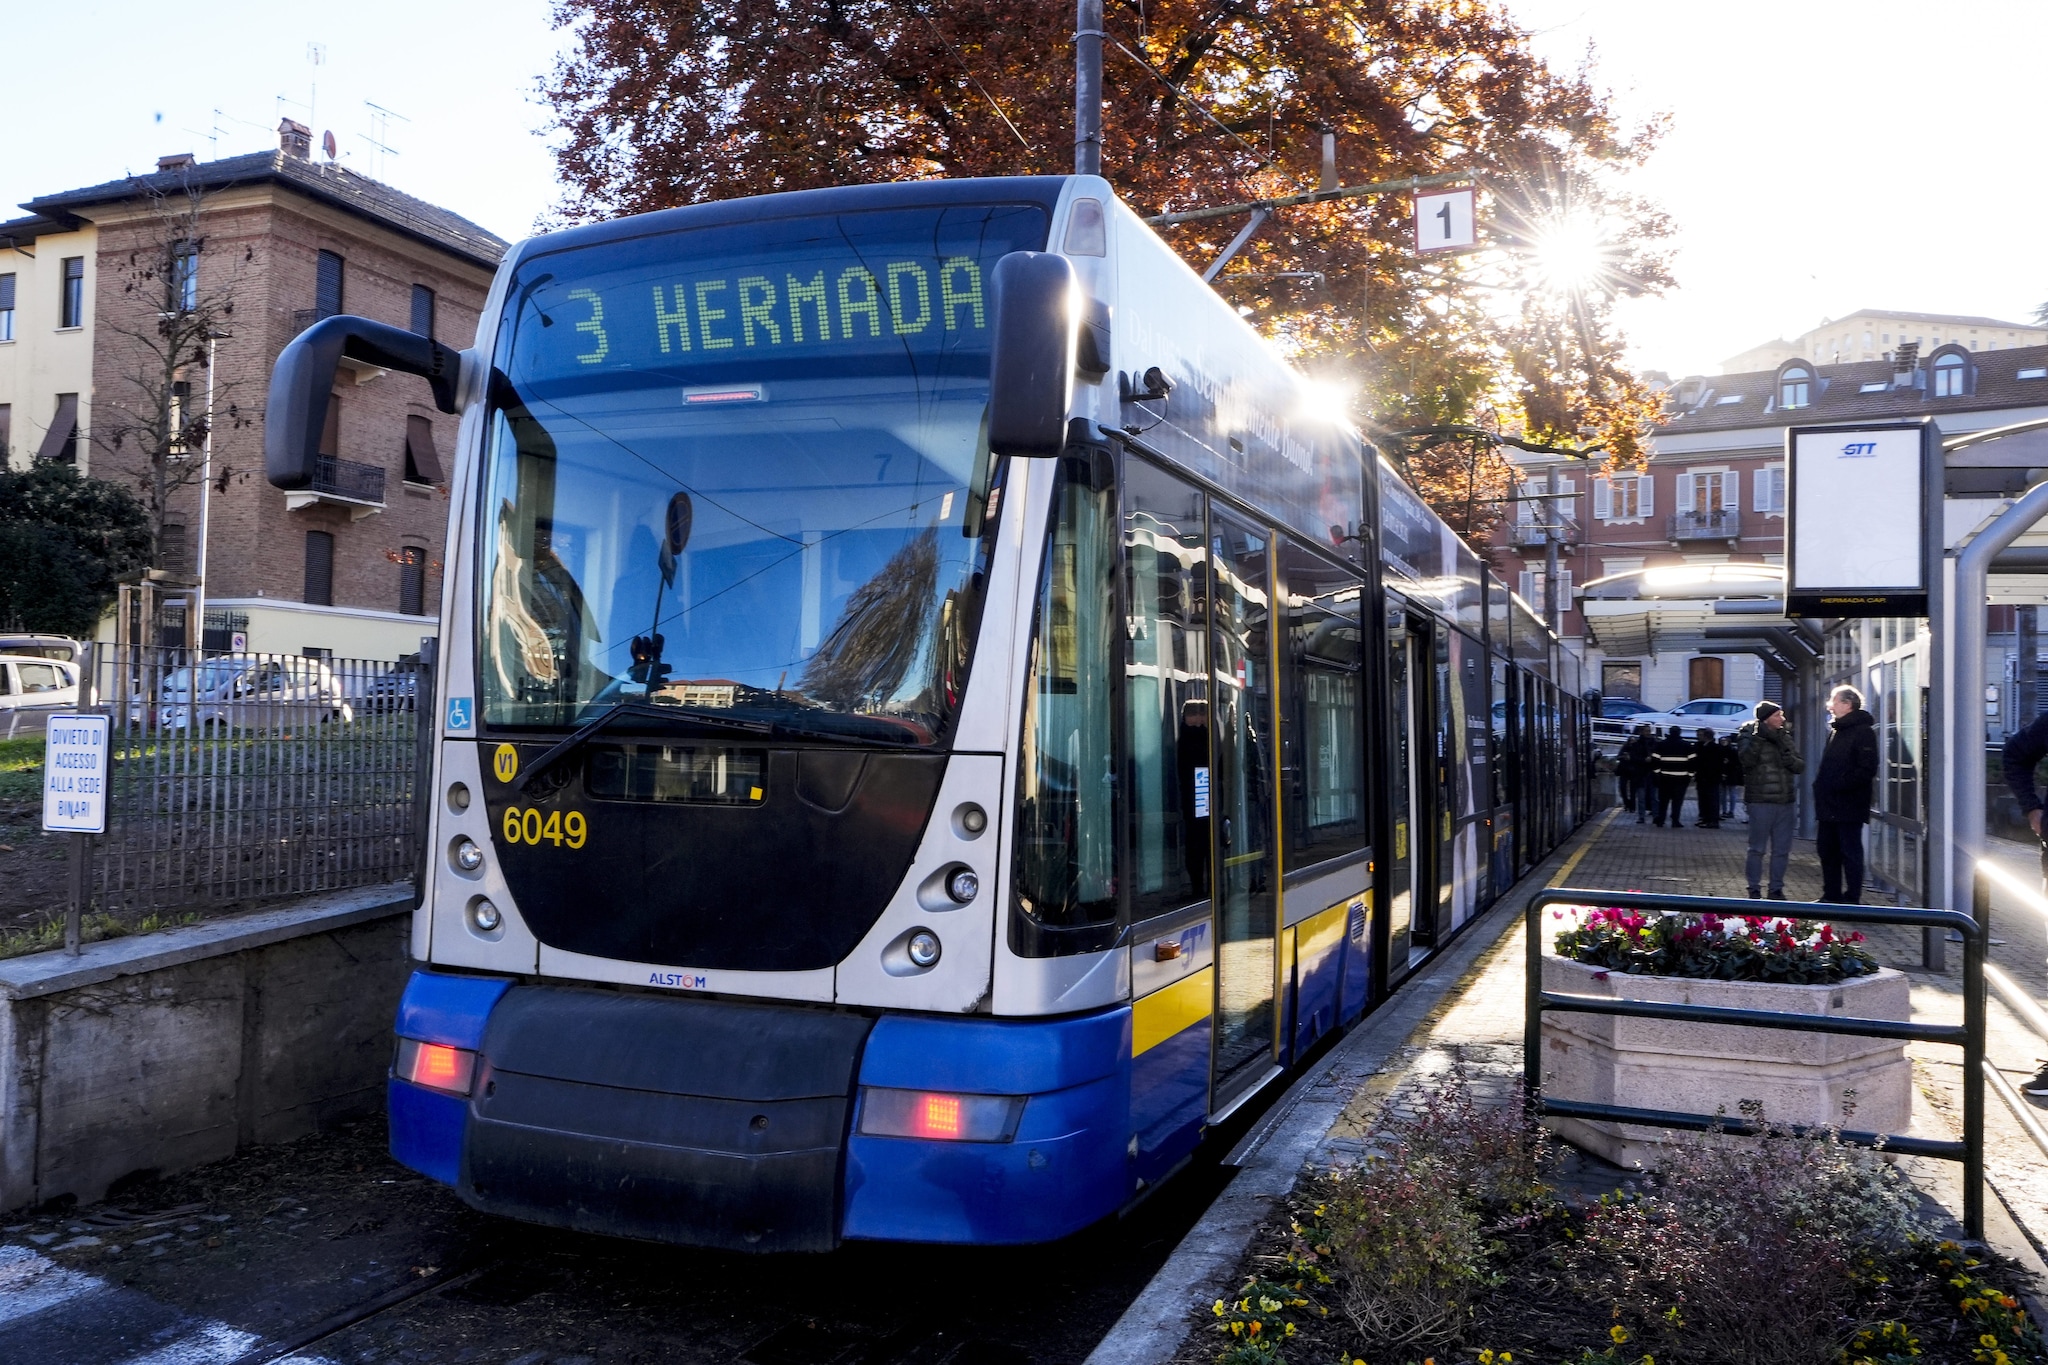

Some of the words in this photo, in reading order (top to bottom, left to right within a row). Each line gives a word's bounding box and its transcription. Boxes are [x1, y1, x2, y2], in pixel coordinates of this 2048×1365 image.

[1436, 201, 1451, 239] 1
[567, 288, 609, 364] 3
[653, 256, 986, 353] HERMADA
[1820, 596, 1866, 604] HERMADA
[52, 729, 89, 745] DIVIETO
[92, 730, 102, 746] DI
[55, 752, 97, 769] ACCESSO
[498, 753, 514, 774] V1
[49, 776, 74, 792] ALLA
[77, 777, 101, 794] SEDE
[58, 800, 90, 817] BINARI
[503, 806, 587, 849] 6049
[649, 972, 706, 988] ALSTOM
